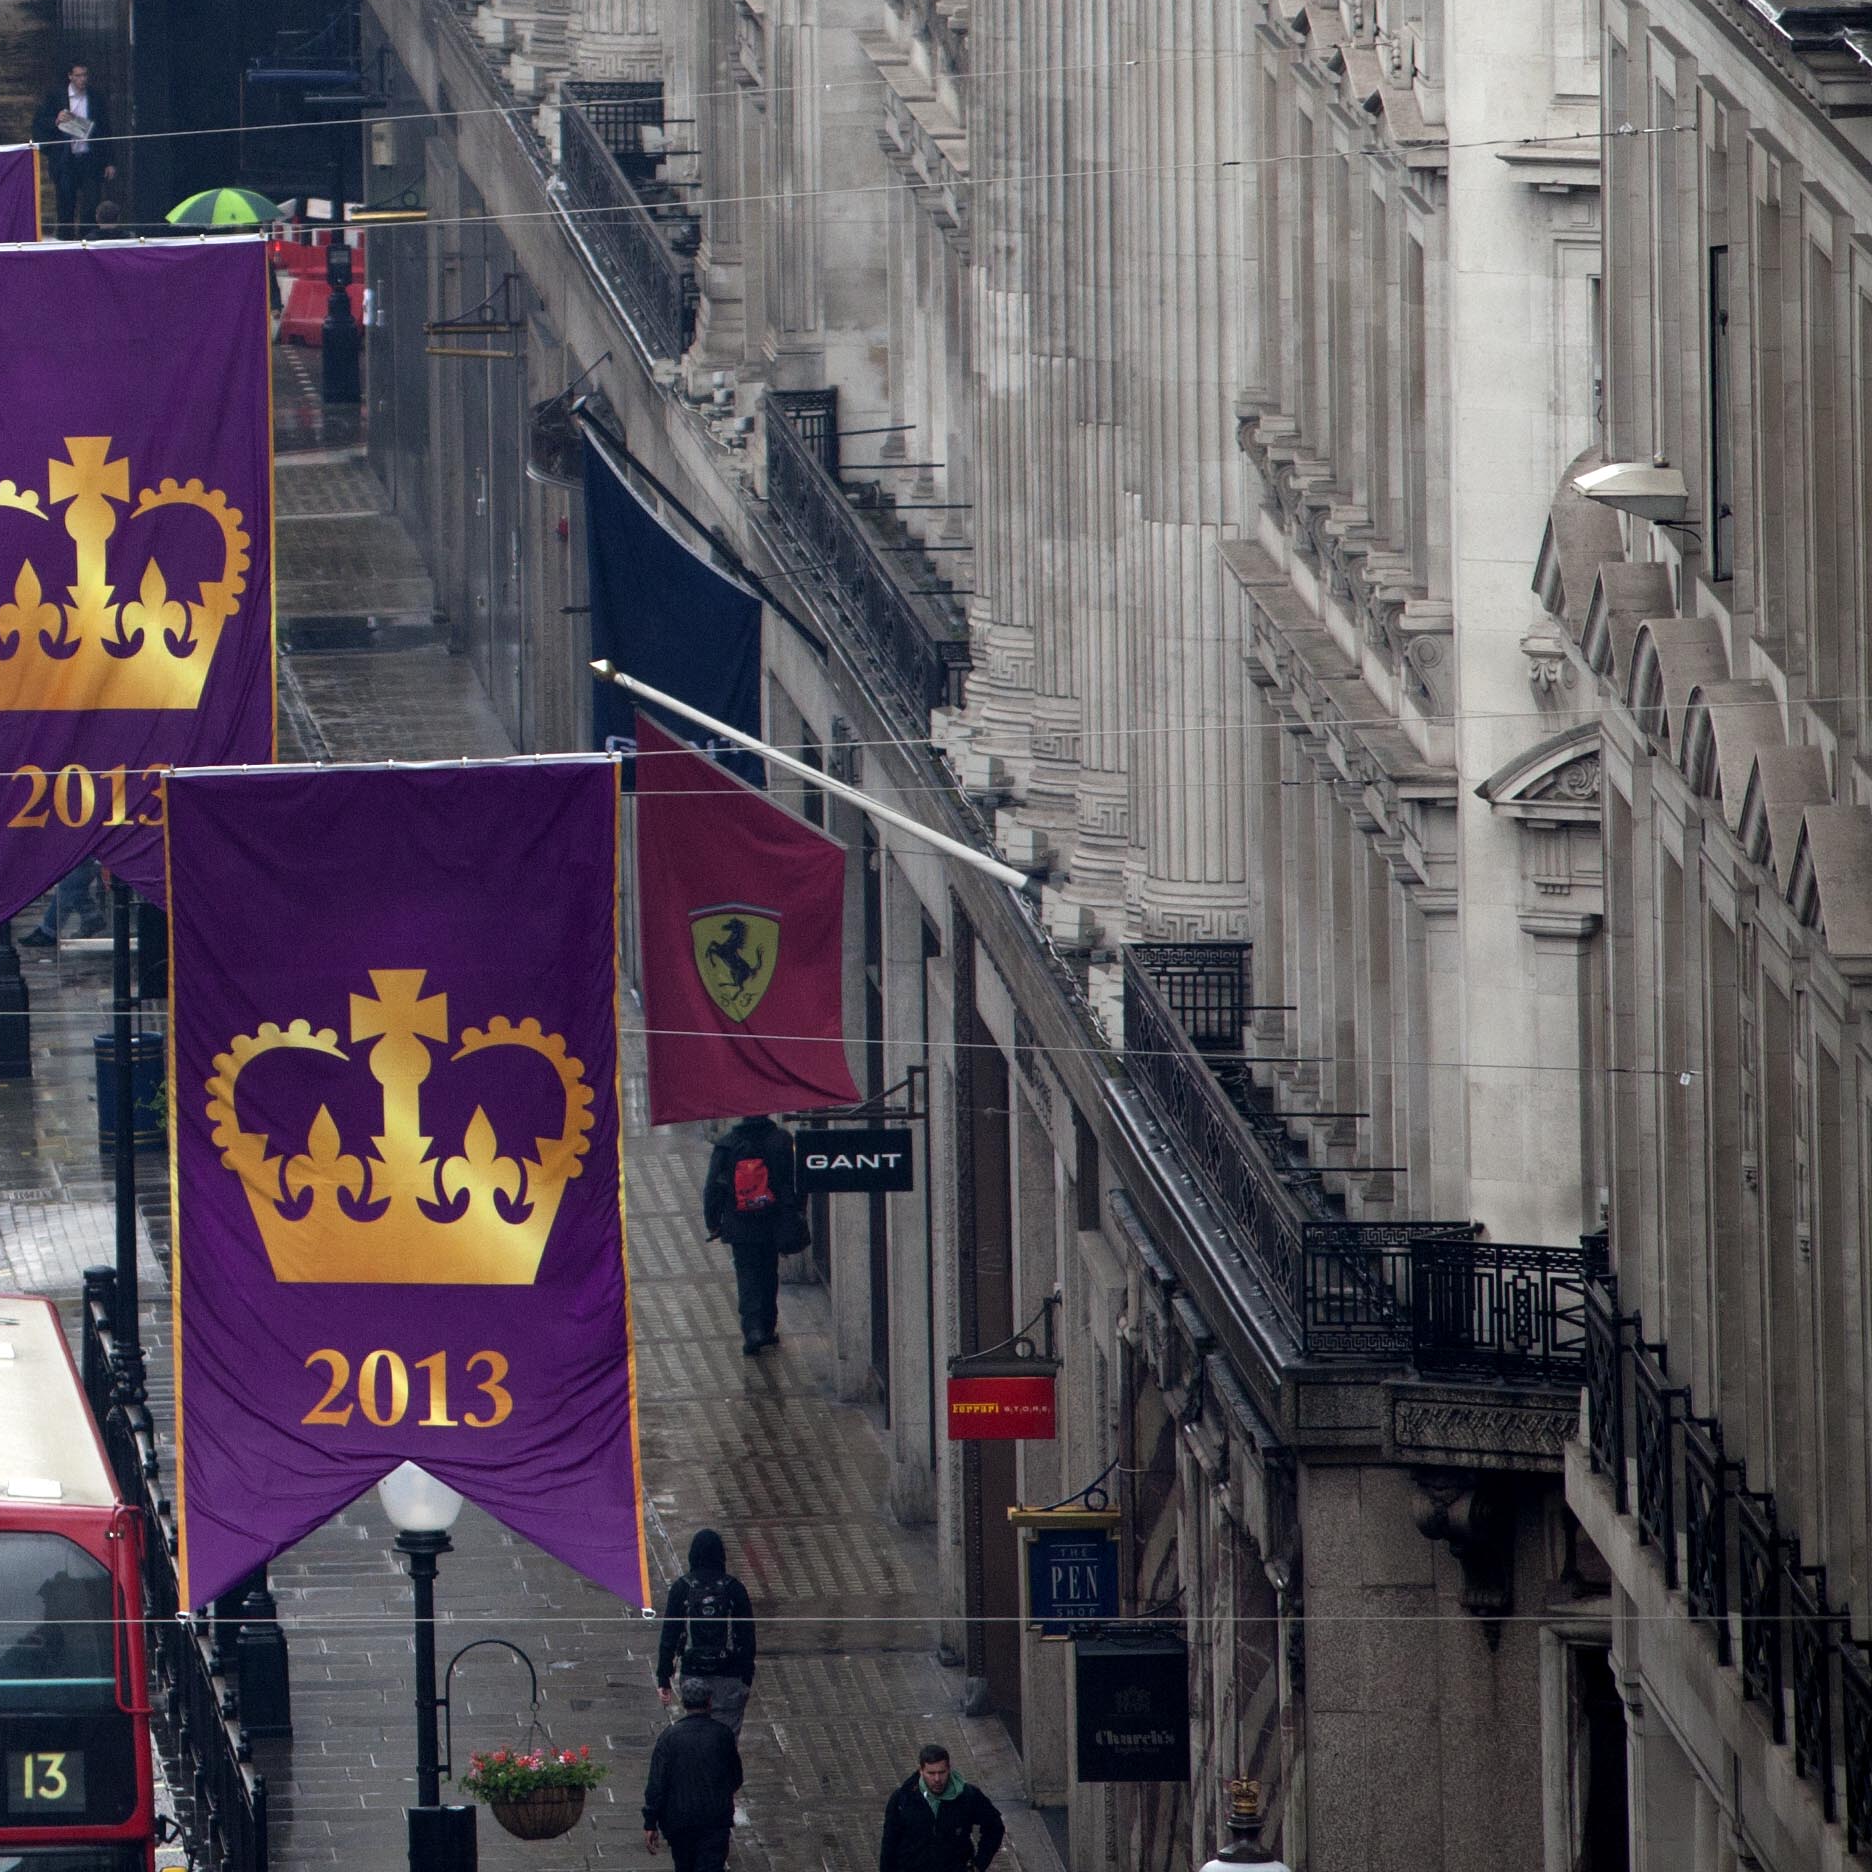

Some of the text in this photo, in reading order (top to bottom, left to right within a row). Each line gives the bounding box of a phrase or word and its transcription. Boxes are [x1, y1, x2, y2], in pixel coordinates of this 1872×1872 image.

[806, 1154, 902, 1169] GANT
[302, 1349, 512, 1427] 2013
[952, 1402, 999, 1414] Ferrari
[1060, 1548, 1088, 1558] THE
[1051, 1565, 1101, 1601] PEN
[1057, 1608, 1097, 1618] SHOP
[1095, 1730, 1176, 1747] Church's
[23, 1752, 68, 1801] 13
